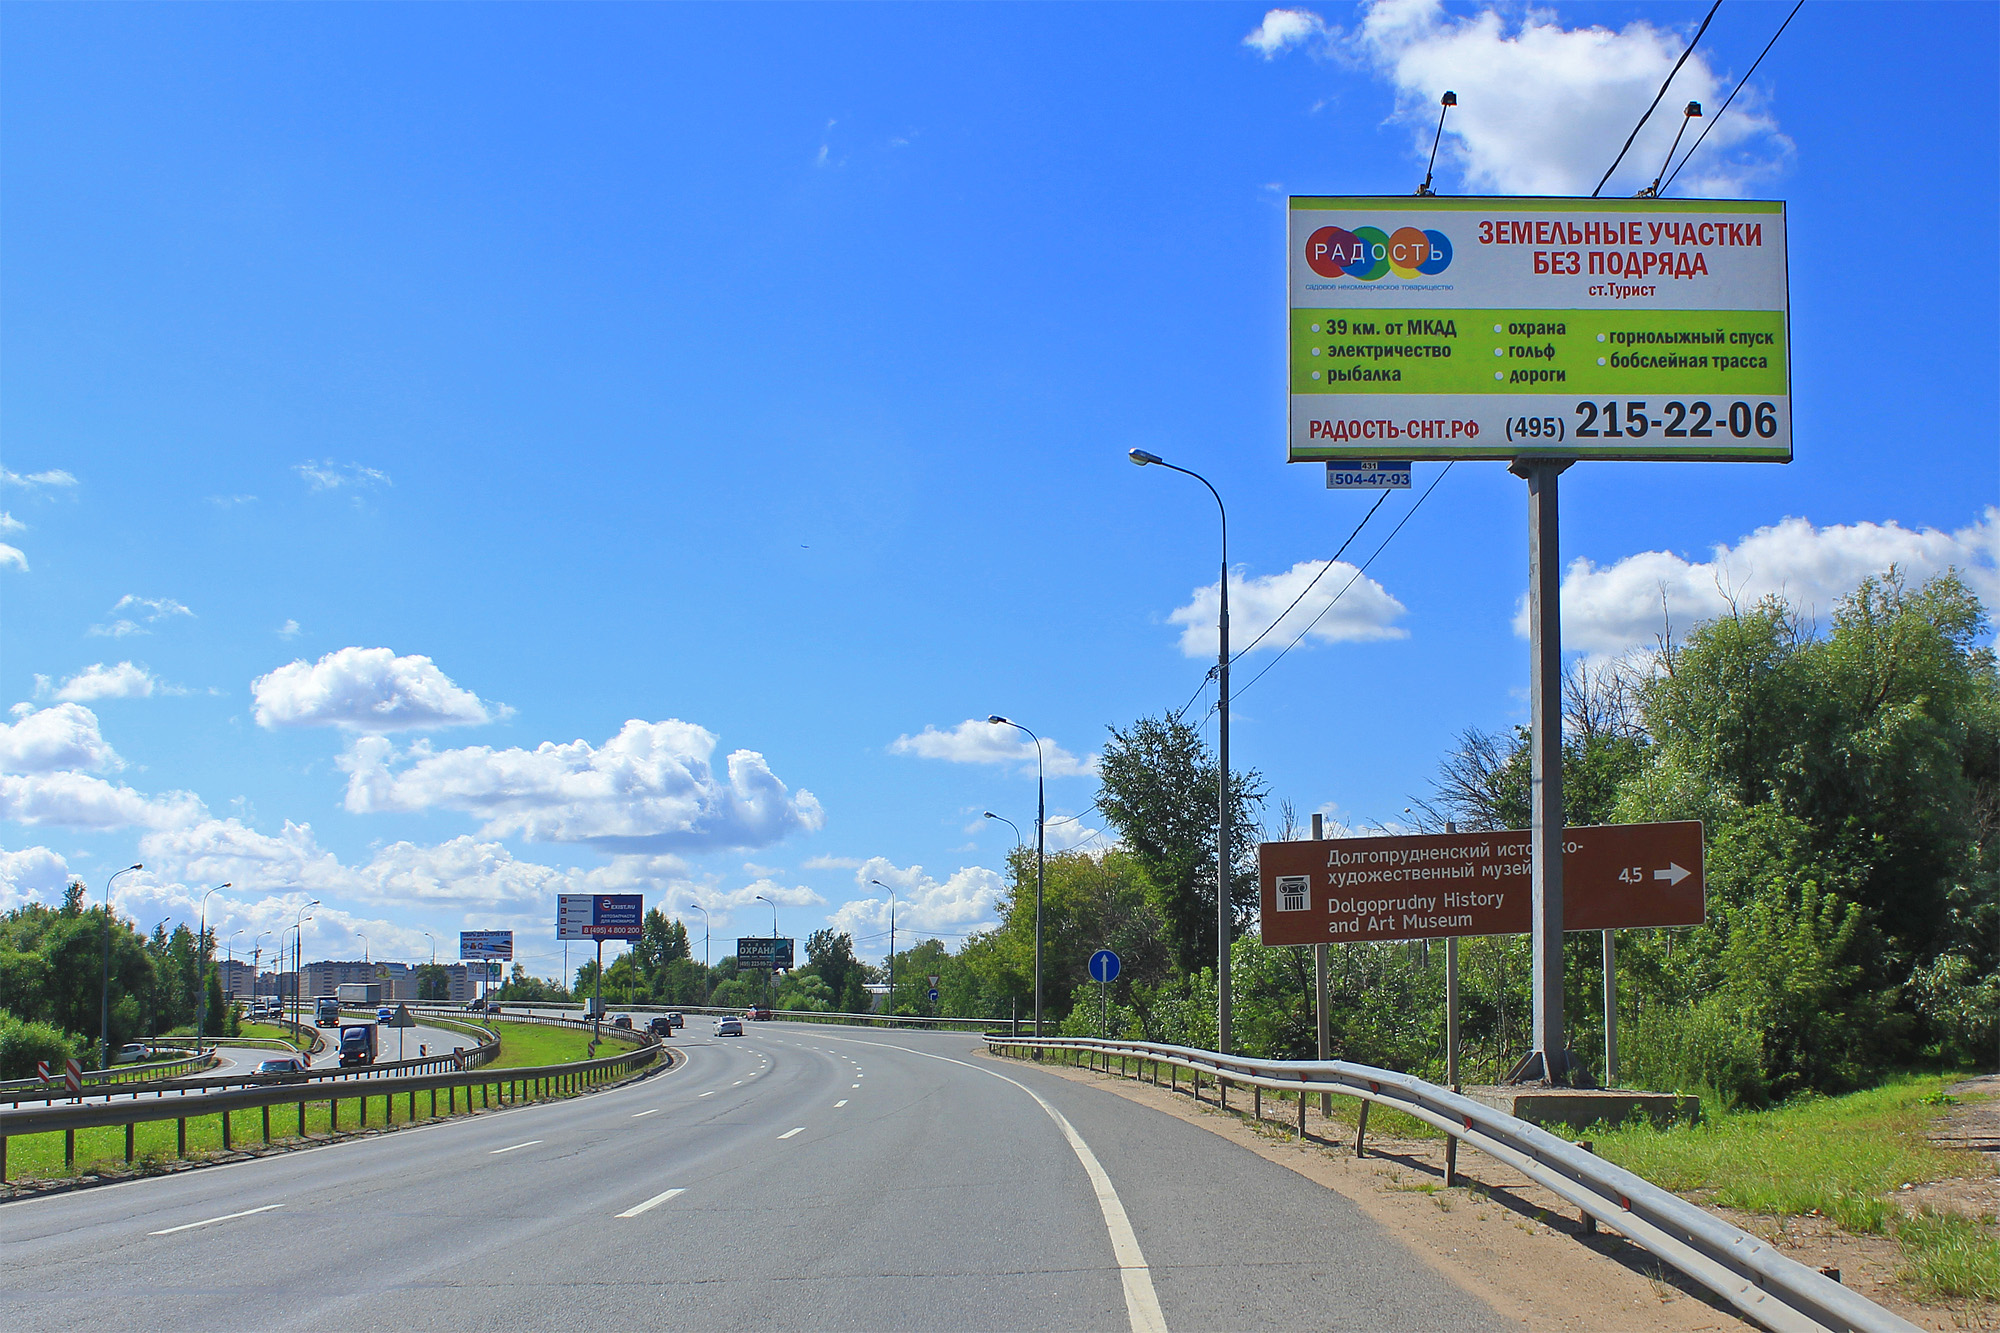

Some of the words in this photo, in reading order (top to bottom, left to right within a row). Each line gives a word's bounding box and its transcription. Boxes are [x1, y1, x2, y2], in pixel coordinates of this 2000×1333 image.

[1478, 220, 1643, 245] ЗЕМЕЛЬНЫЕ
[1647, 222, 1762, 247] УЧАСТКИ
[1314, 242, 1444, 264] РАДОСТЬ
[1533, 250, 1581, 275] БЕЗ
[1588, 251, 1709, 280] ПОДРЯДА
[1338, 284, 1399, 292] некоммерческое
[1402, 284, 1454, 292] товарищество
[1588, 282, 1656, 299] ст.Турист
[1326, 319, 1348, 335] 39
[1352, 322, 1381, 335] км.
[1385, 322, 1403, 335] от
[1407, 319, 1457, 338] МКАД
[1508, 322, 1566, 338] охрана
[1609, 329, 1725, 347] горнолыжный
[1729, 331, 1774, 348] спуск
[1327, 345, 1452, 361] электричество
[1508, 343, 1556, 361] гольф
[1610, 351, 1708, 368] бобслейная
[1712, 355, 1768, 371] трасса
[1327, 365, 1401, 384] рыбалка
[1509, 368, 1566, 385] дороги
[1309, 419, 1480, 442] РАДОСТЬ-СНТ.РФ
[1505, 417, 1565, 442] (495)
[1575, 401, 1777, 438] 215-22-06
[1361, 462, 1377, 470] 431
[1335, 473, 1410, 485] 504-47-93
[1327, 842, 1490, 867] Долгопрудненский
[1328, 862, 1475, 888] художественный
[1481, 859, 1532, 880] музей
[1618, 867, 1643, 885] 4,5
[1328, 894, 1436, 916] Dolgoprudny
[1444, 892, 1504, 909] History
[1328, 917, 1360, 934] and
[1367, 915, 1396, 932] Art
[1403, 913, 1473, 930] Museum
